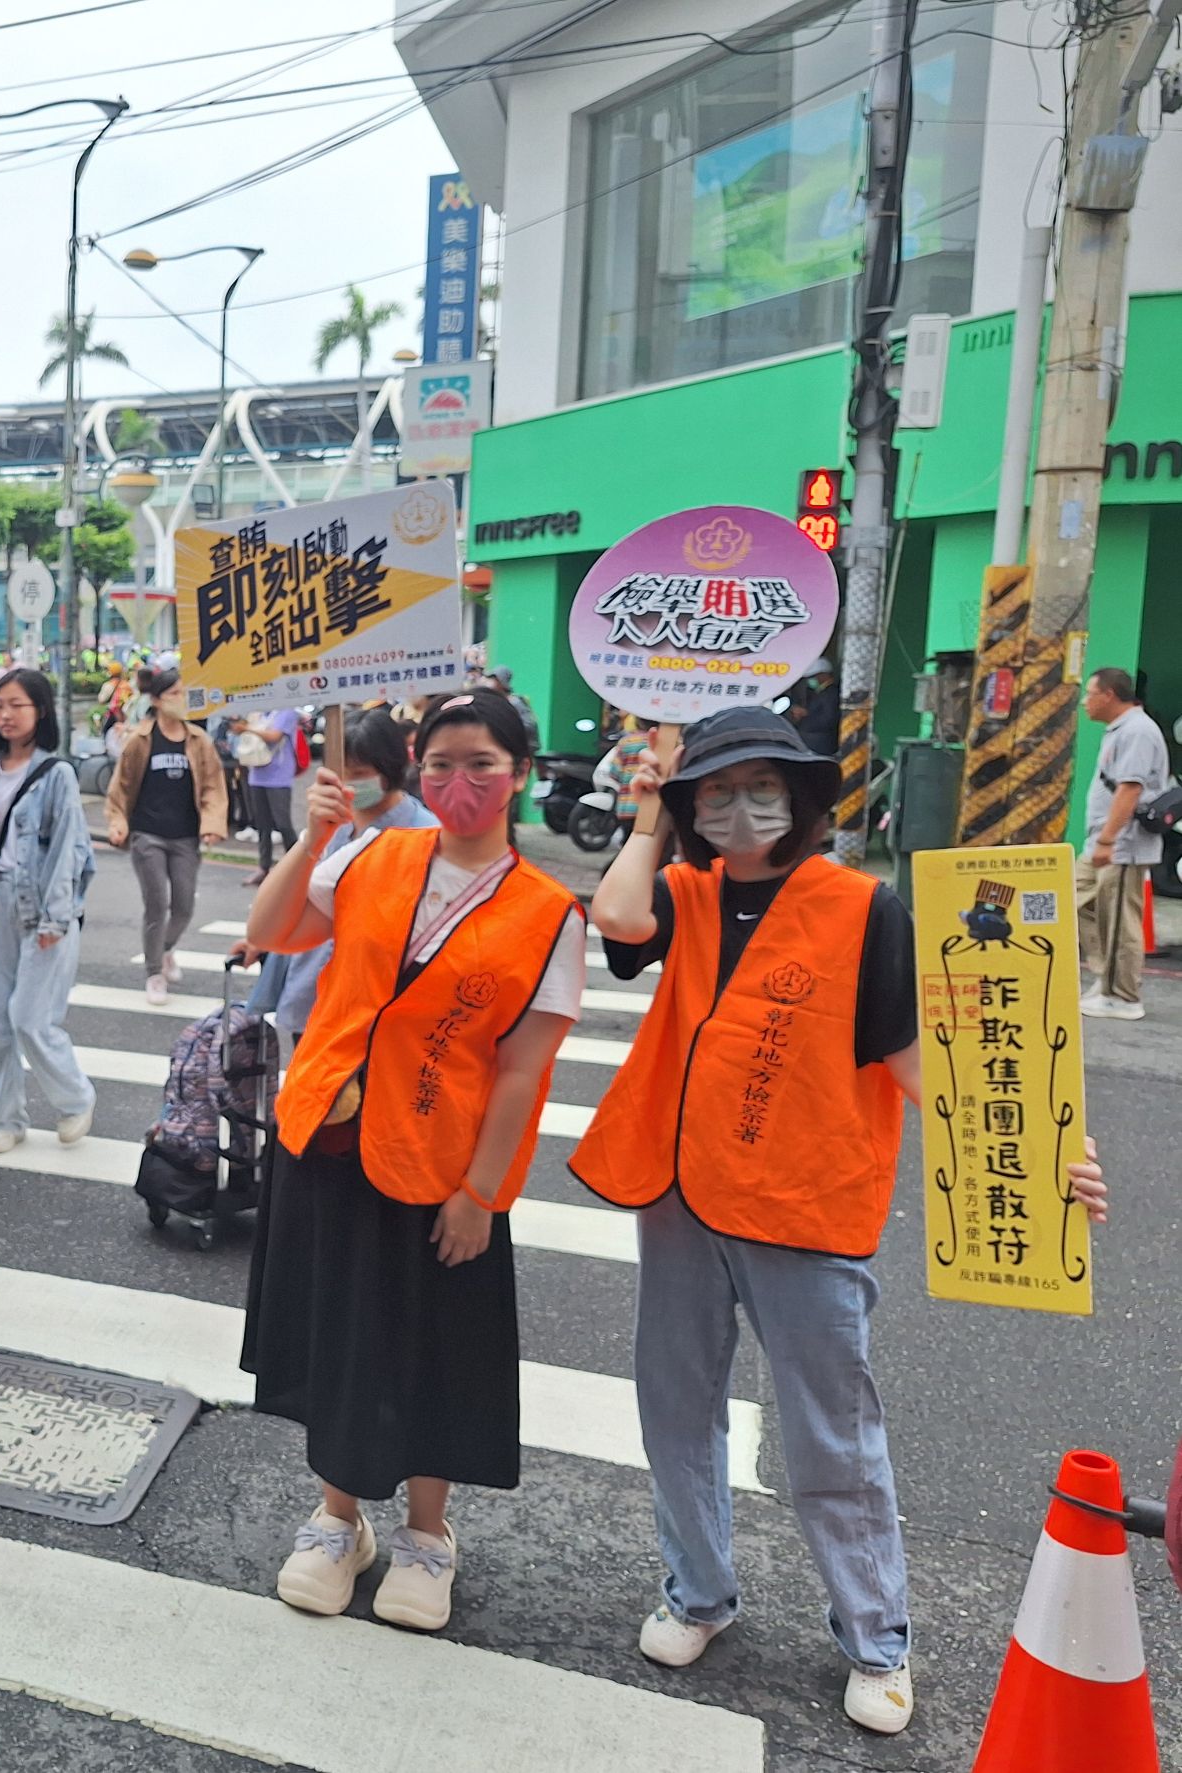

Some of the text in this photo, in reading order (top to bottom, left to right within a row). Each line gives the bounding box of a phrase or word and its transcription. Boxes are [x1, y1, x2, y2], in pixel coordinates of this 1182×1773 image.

[210, 520, 267, 578] 查賄
[21, 580, 40, 606] 停
[250, 536, 391, 667] 全面出擊
[597, 574, 808, 622] 檢舉賄選
[609, 612, 780, 650] 人人有責
[324, 650, 406, 670] 0800024099
[648, 656, 790, 676] 0800-024-099
[733, 1008, 794, 1145] 彰化地方檢察署
[978, 975, 1030, 1265] 詐欺集團退散符
